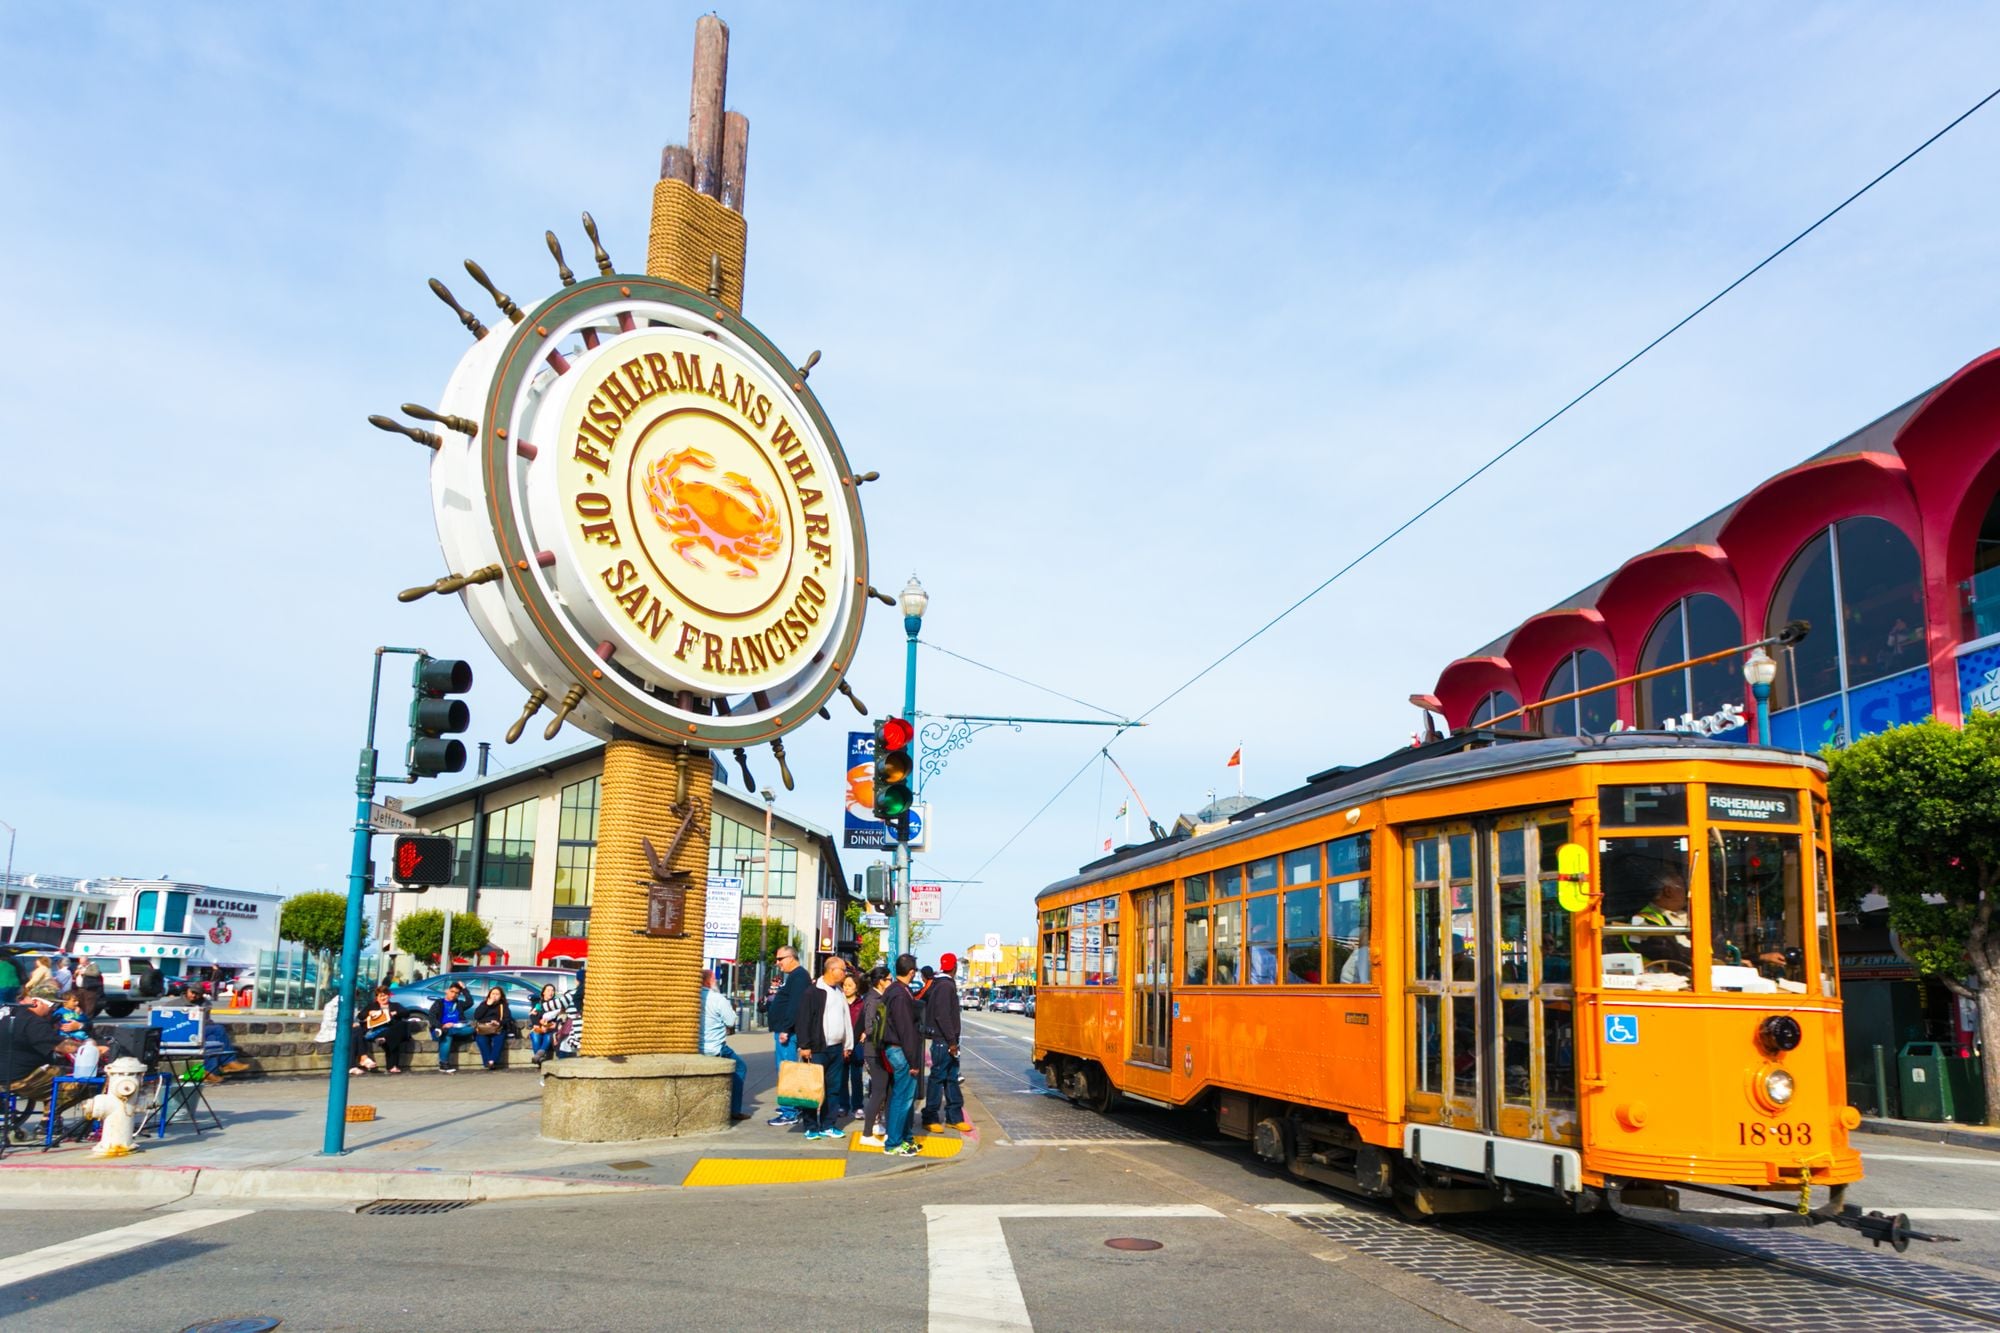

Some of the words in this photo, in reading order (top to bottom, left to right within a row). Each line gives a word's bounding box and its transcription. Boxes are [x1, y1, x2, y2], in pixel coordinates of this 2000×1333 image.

[573, 350, 773, 476] FISHERMANS
[770, 415, 832, 568] WHARF
[575, 492, 621, 549] OF
[601, 558, 675, 642] SAN
[673, 575, 828, 675] FRANCISCO
[857, 738, 875, 751] PO
[1623, 787, 1666, 822] F
[1709, 795, 1787, 813] FISHERMAN'S
[374, 808, 412, 829] Jefferson
[1738, 1122, 1812, 1146] 1893
